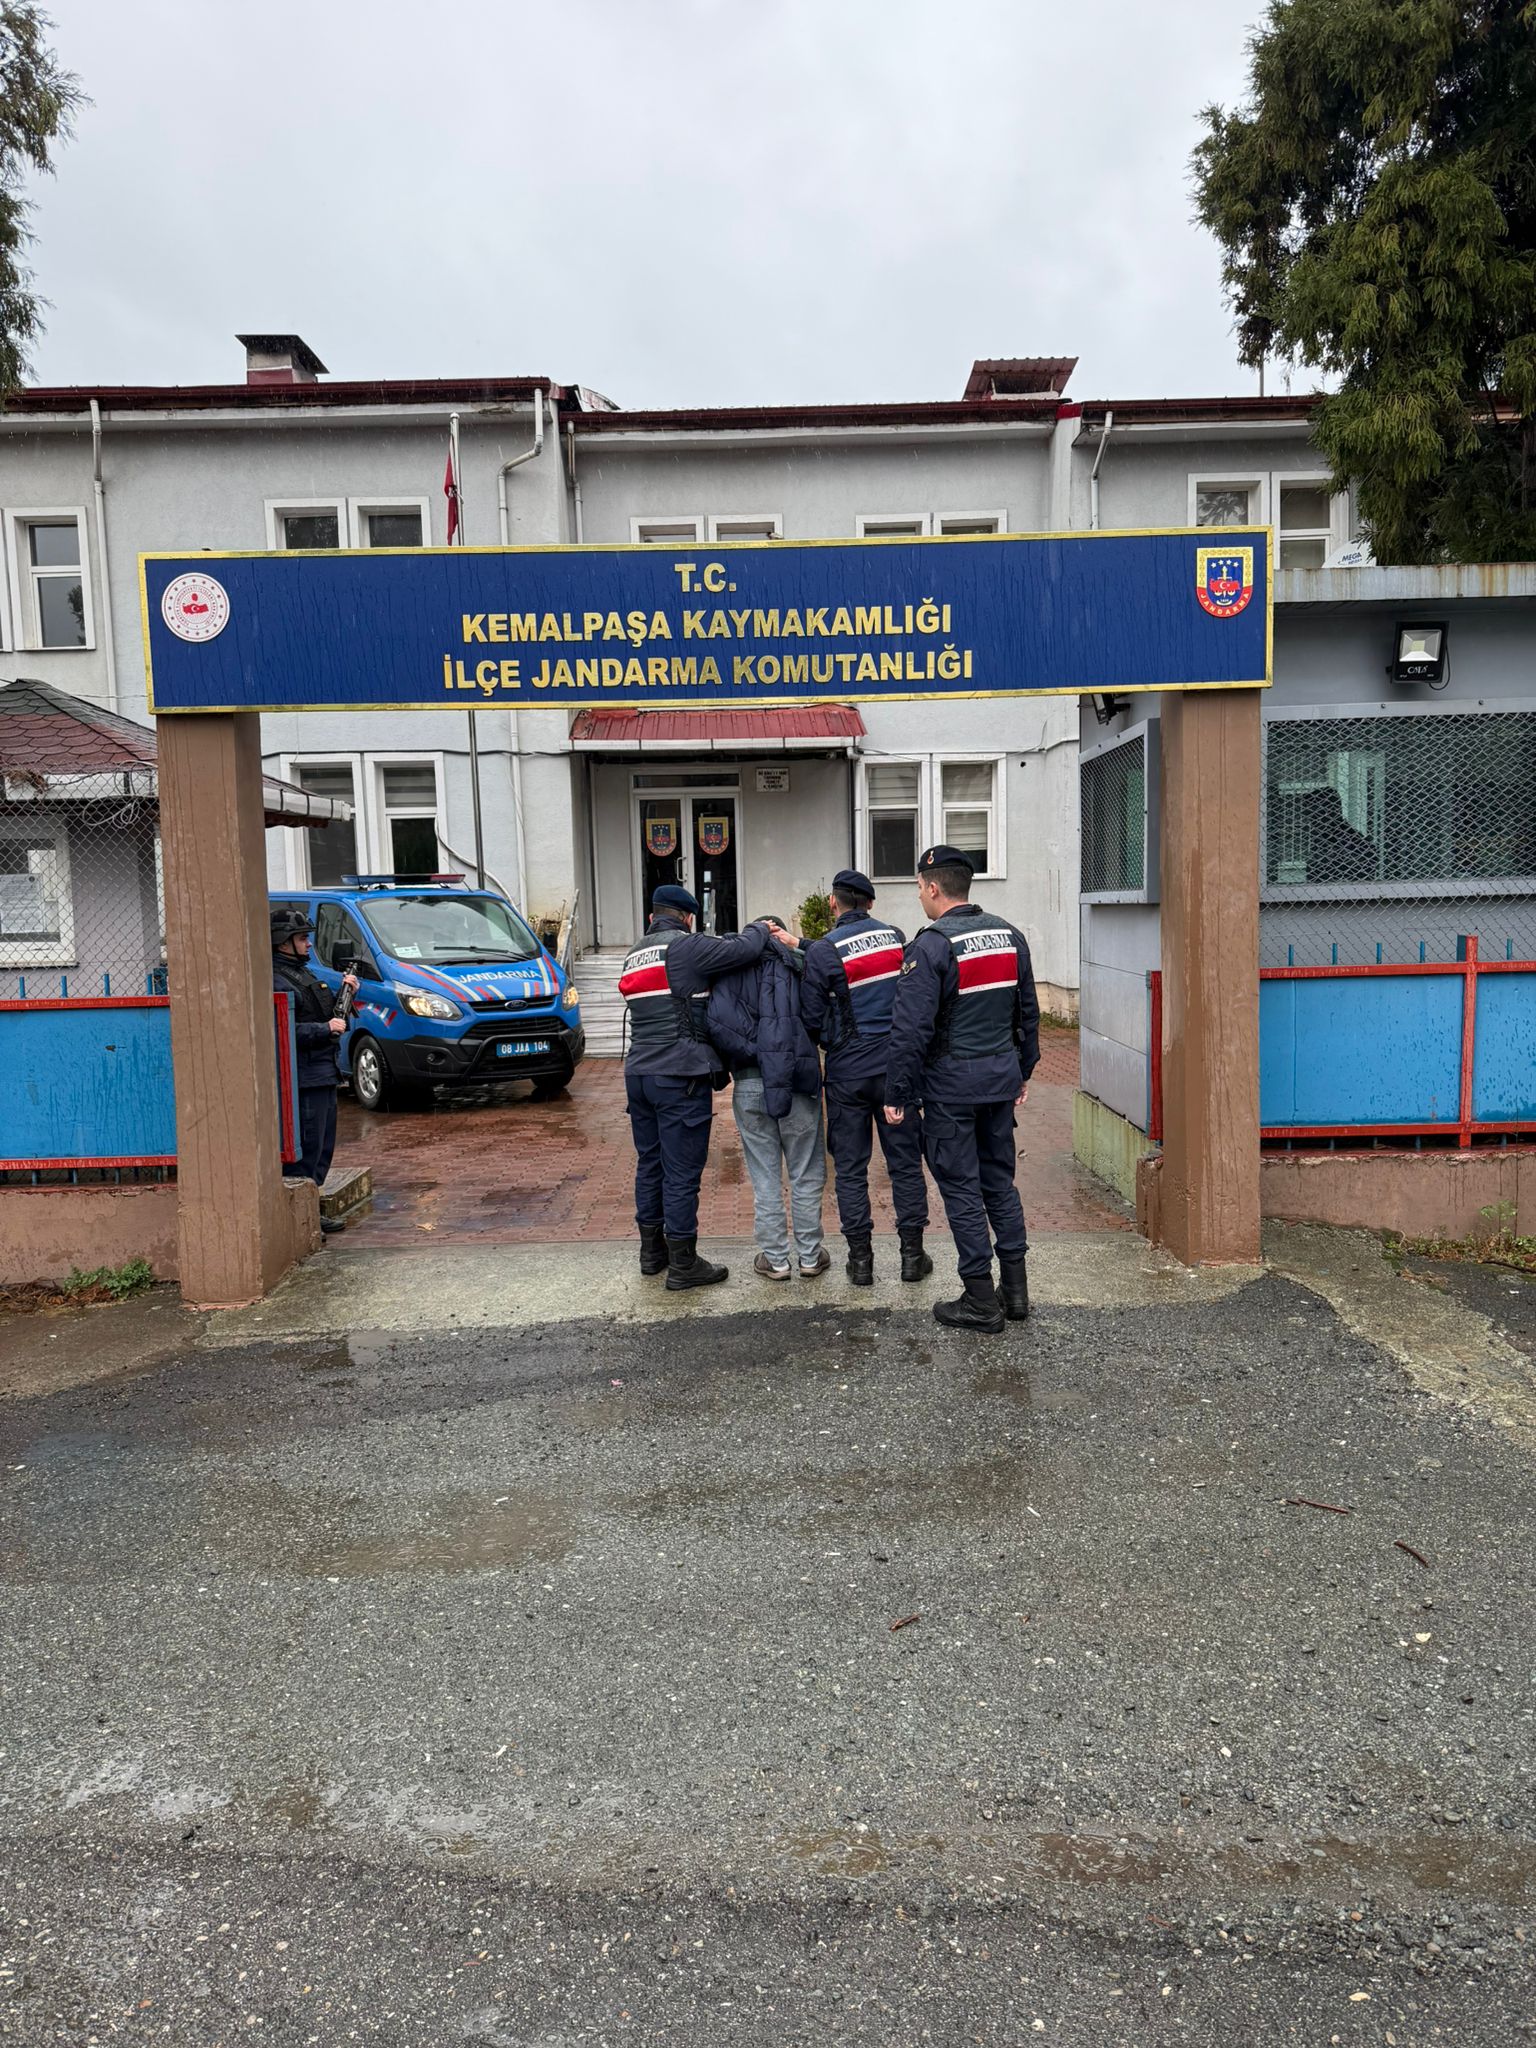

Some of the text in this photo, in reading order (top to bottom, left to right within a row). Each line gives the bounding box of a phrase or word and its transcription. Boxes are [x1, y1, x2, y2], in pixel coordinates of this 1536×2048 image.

[1342, 552, 1362, 562] MEGA
[674, 563, 737, 592] T.C.
[1200, 593, 1250, 615] JANDARMA
[462, 597, 951, 647] KEMALPAŞA KAYMAKAMLIĞI
[443, 643, 972, 696] İLÇE JANDARMA KOMUTANLIĞI
[847, 932, 897, 955] JANDARMA
[963, 934, 1012, 953] JANDARMA
[459, 969, 542, 983] JANDARMA
[501, 1040, 548, 1054] 08 JAA 104
